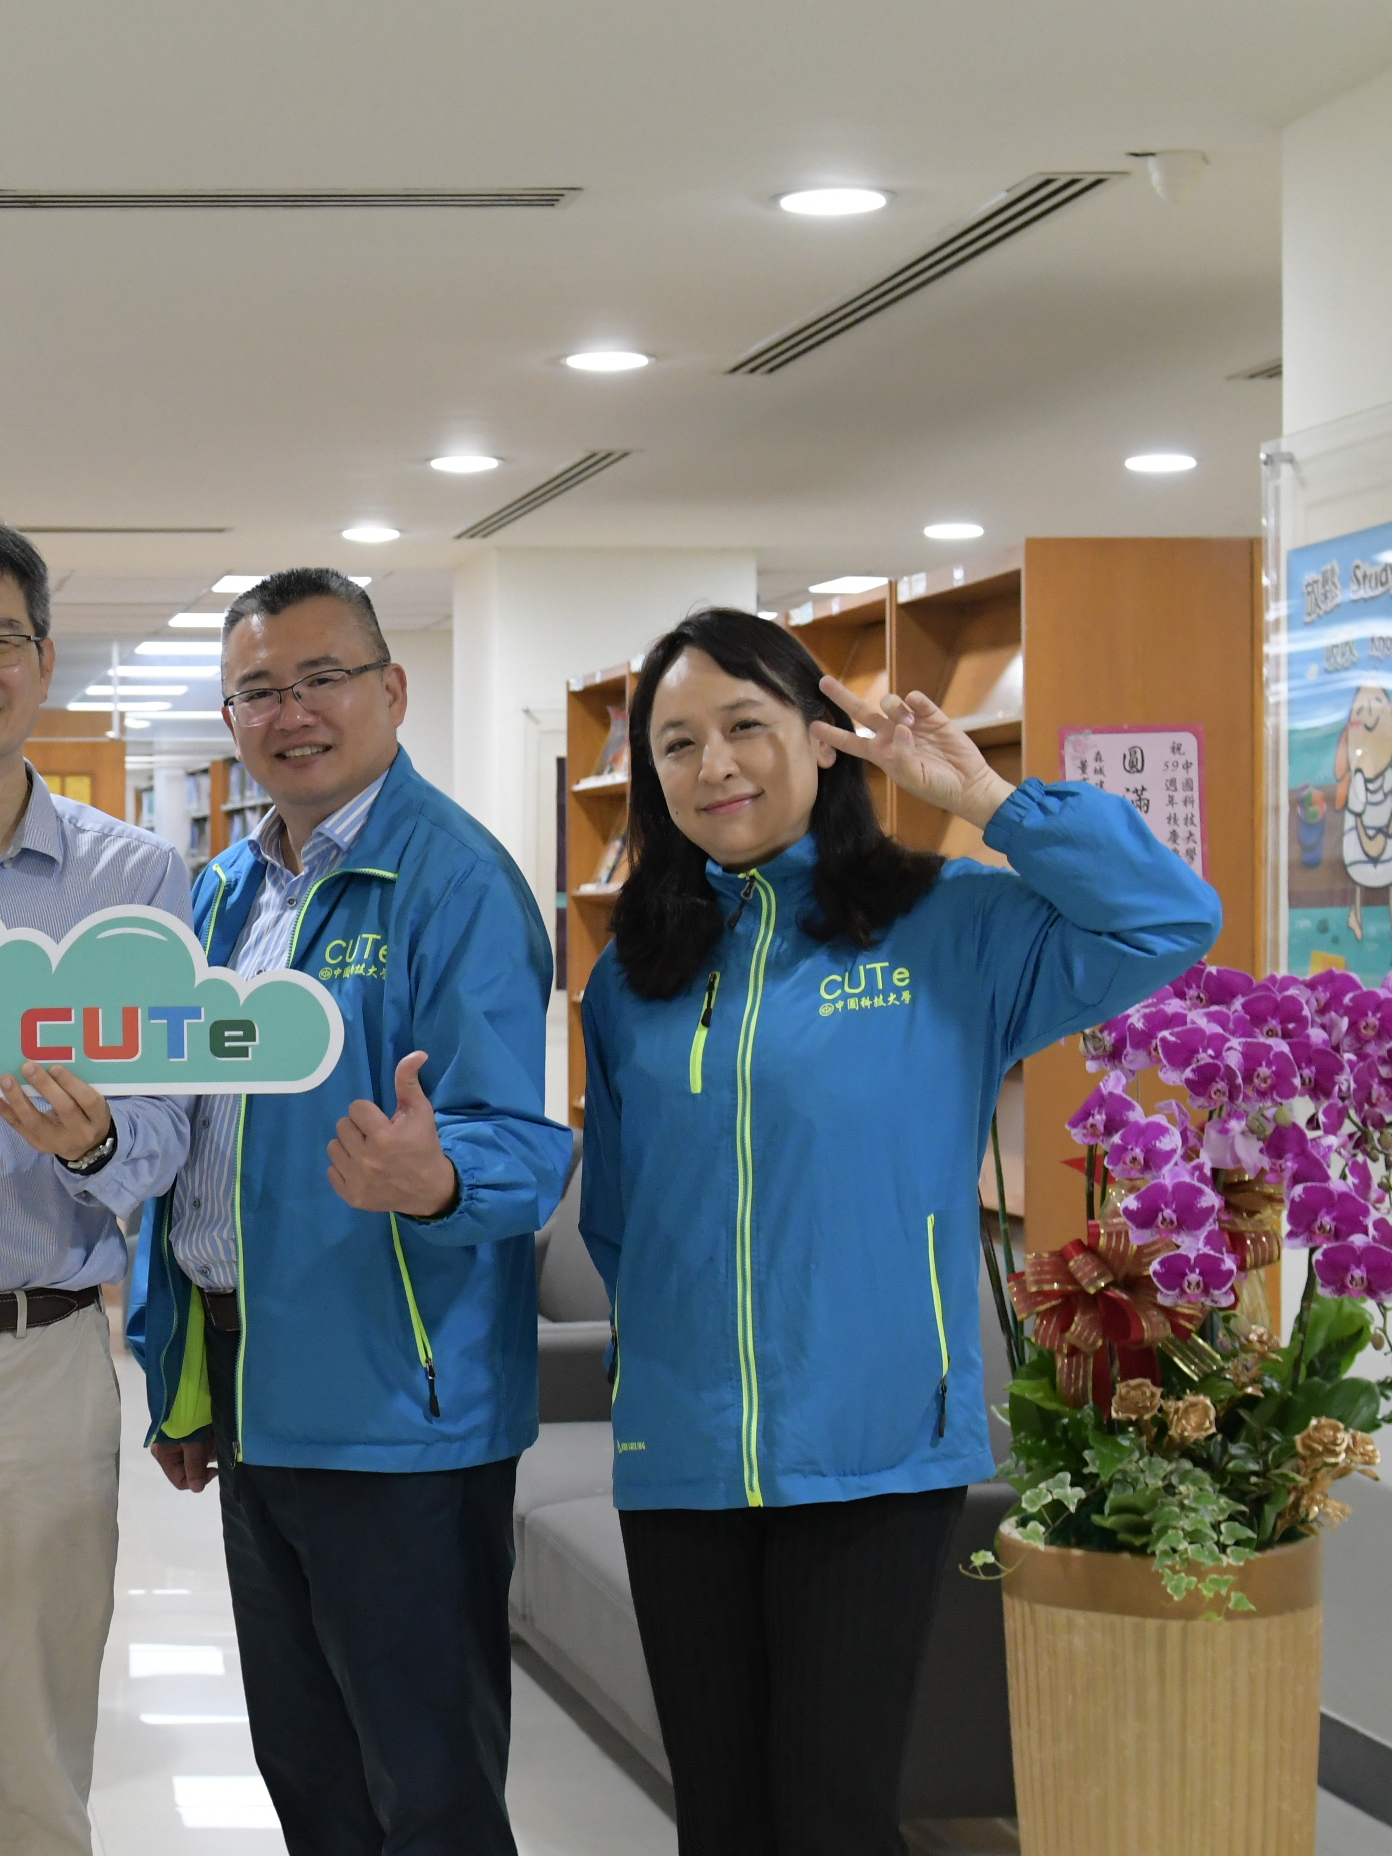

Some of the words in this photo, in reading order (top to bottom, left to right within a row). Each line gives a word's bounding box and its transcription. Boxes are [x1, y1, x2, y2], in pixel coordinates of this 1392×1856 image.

[1181, 758, 1198, 865] 中國科技大學
[819, 961, 911, 1000] CUTe
[834, 990, 912, 1013] 中國科技大學
[19, 1005, 259, 1063] CUTe
